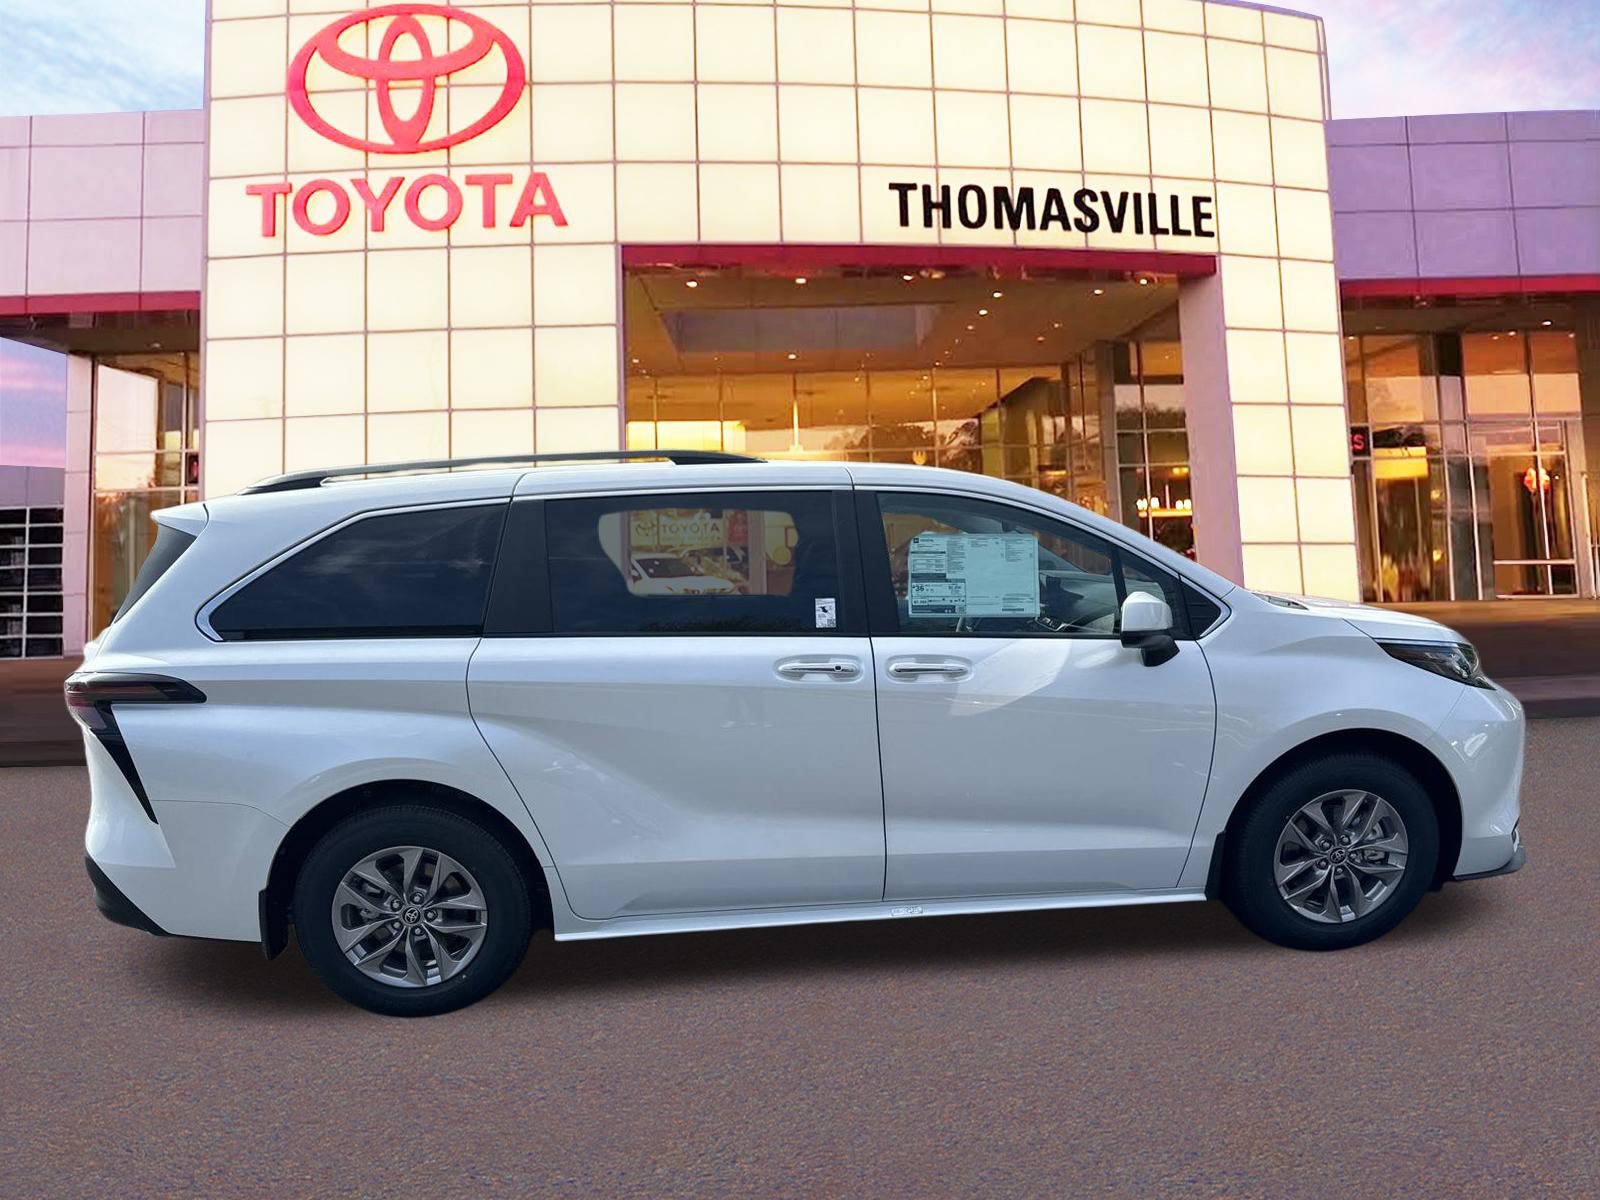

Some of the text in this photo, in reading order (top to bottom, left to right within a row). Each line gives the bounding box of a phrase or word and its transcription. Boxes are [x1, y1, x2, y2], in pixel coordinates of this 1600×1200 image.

[246, 172, 568, 237] TOYOTA
[888, 182, 1215, 237] THOMASVILLE
[661, 522, 720, 534] TOYOTA
